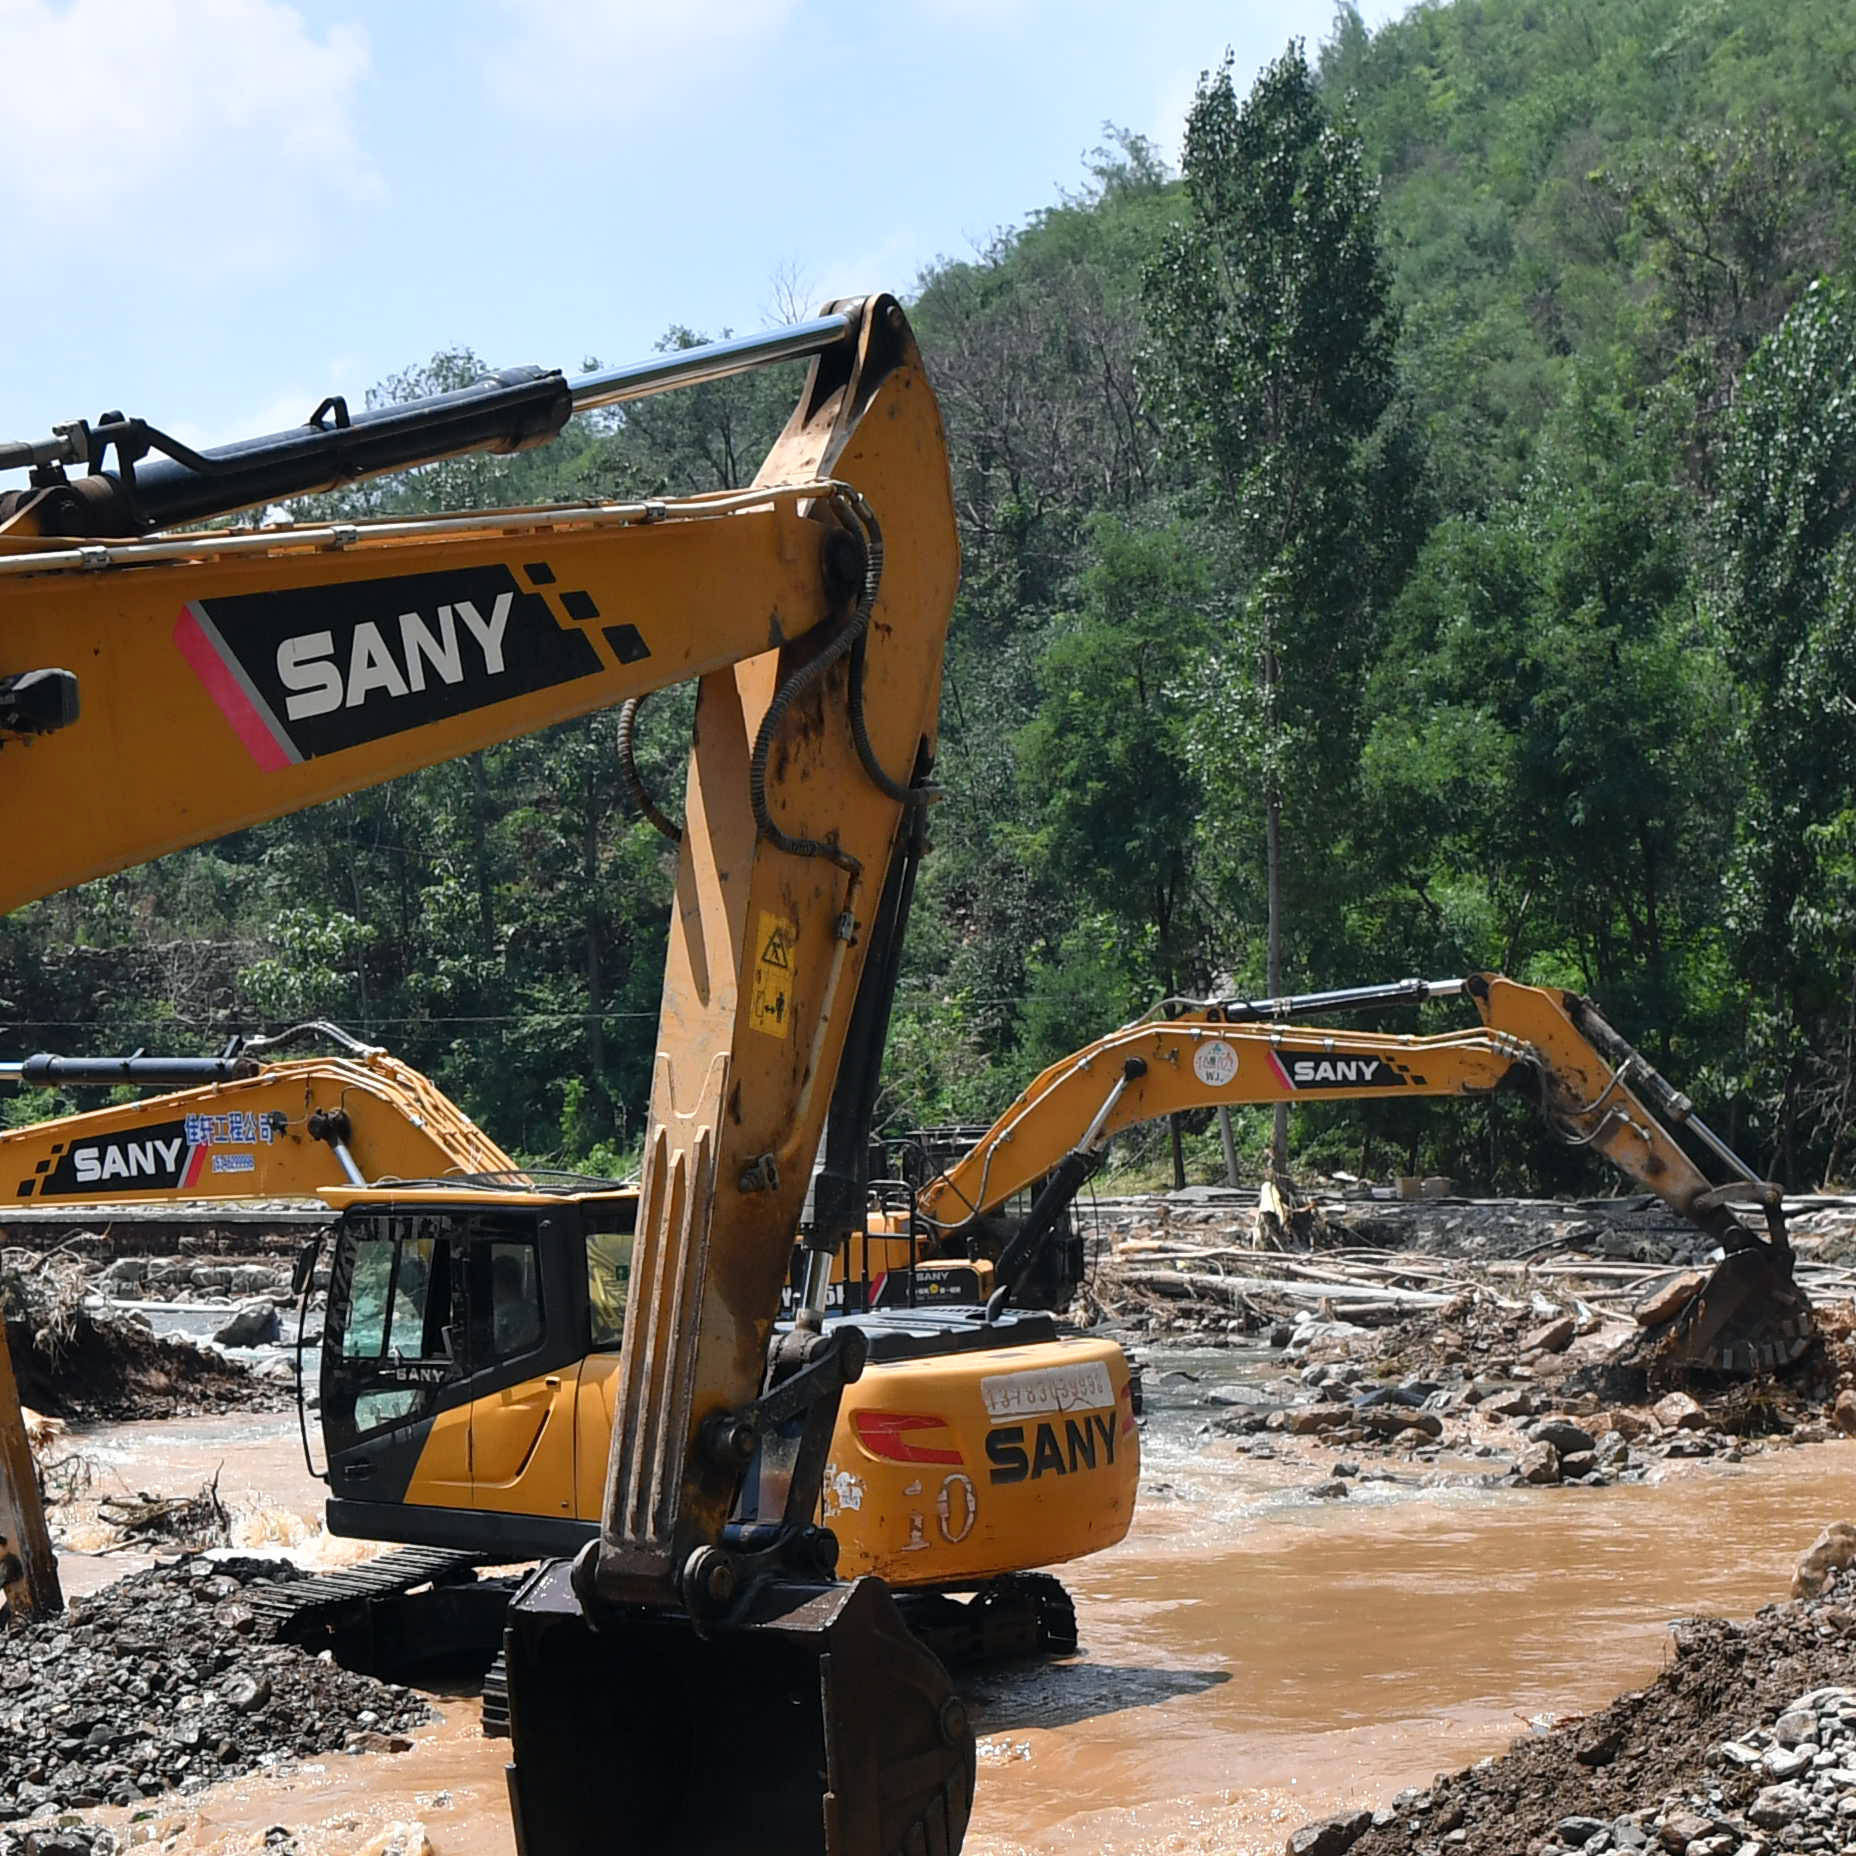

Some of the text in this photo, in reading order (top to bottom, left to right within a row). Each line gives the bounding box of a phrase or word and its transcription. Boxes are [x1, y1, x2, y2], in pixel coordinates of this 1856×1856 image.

[277, 592, 514, 721] SANY
[1294, 1061, 1380, 1081] SANY
[74, 1138, 183, 1182] SANY
[915, 1272, 950, 1283] SANY
[396, 1367, 445, 1383] SANY
[985, 1411, 1116, 1485] SANY
